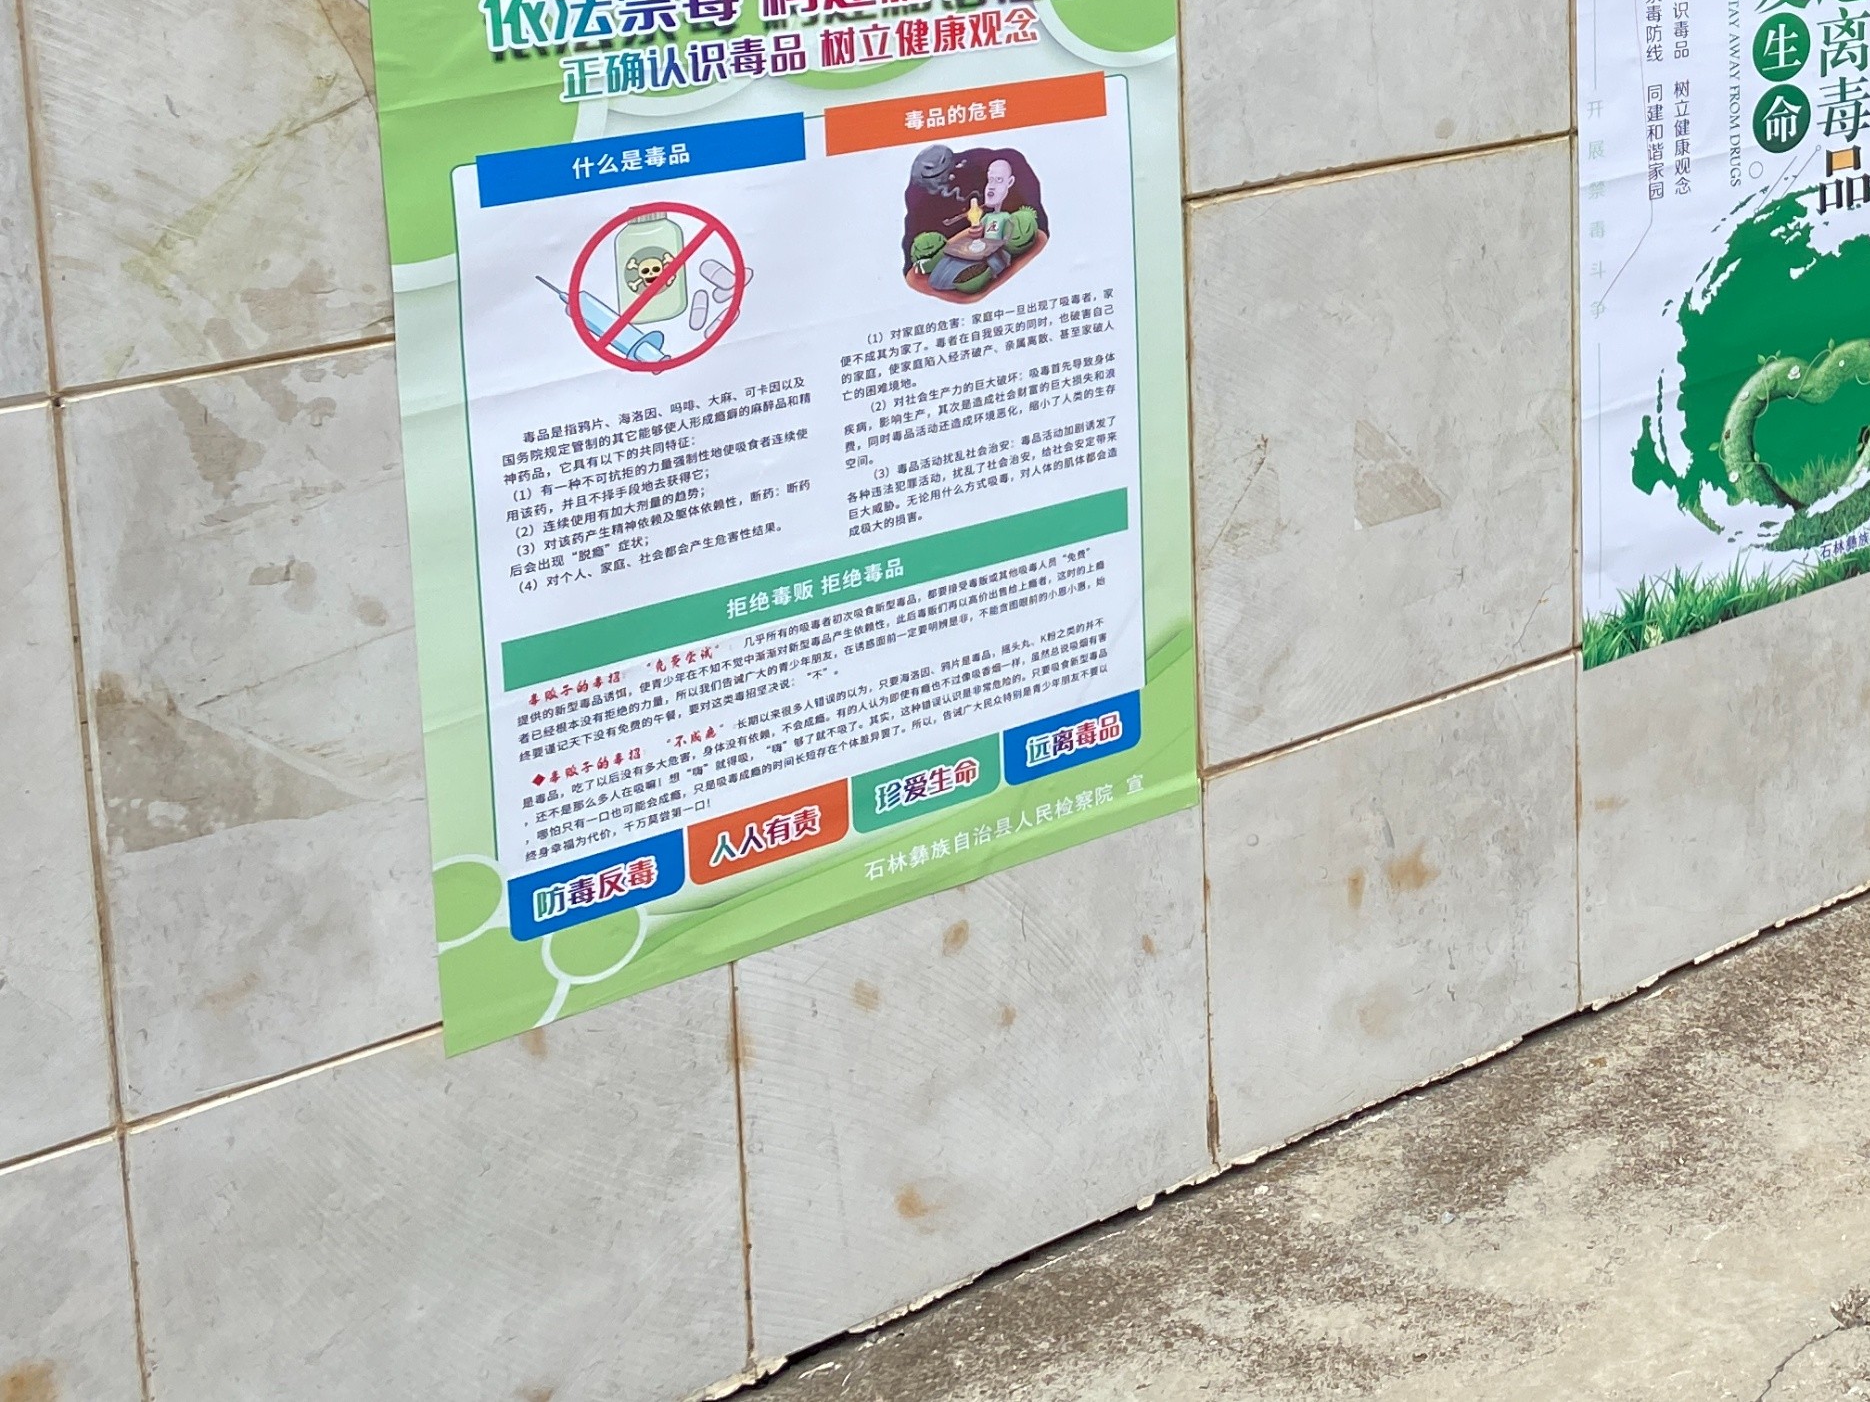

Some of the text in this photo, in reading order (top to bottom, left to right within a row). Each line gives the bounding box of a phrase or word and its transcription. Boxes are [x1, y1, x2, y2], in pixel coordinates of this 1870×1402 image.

[561, 7, 1039, 102] 正确认识毒品 树立健康观念
[1729, 33, 1741, 80] AWAY
[904, 100, 1008, 131] 毒品的危害
[1673, 79, 1692, 196] 树立健康观念
[1729, 85, 1741, 130] FROM
[572, 145, 691, 181] 什么是毒品
[1646, 83, 1665, 201] 同建和谐家园
[1729, 134, 1742, 188] DRUGS
[726, 555, 904, 621] 拒绝毒贩 拒绝毒品
[1025, 708, 1121, 767] 远离毒品
[874, 753, 978, 814] 珍爱生命
[709, 802, 821, 866] 人人有责
[863, 772, 1144, 882] 石林彝族自治县人民检察院 宣
[534, 852, 659, 921] 防毒反毒
